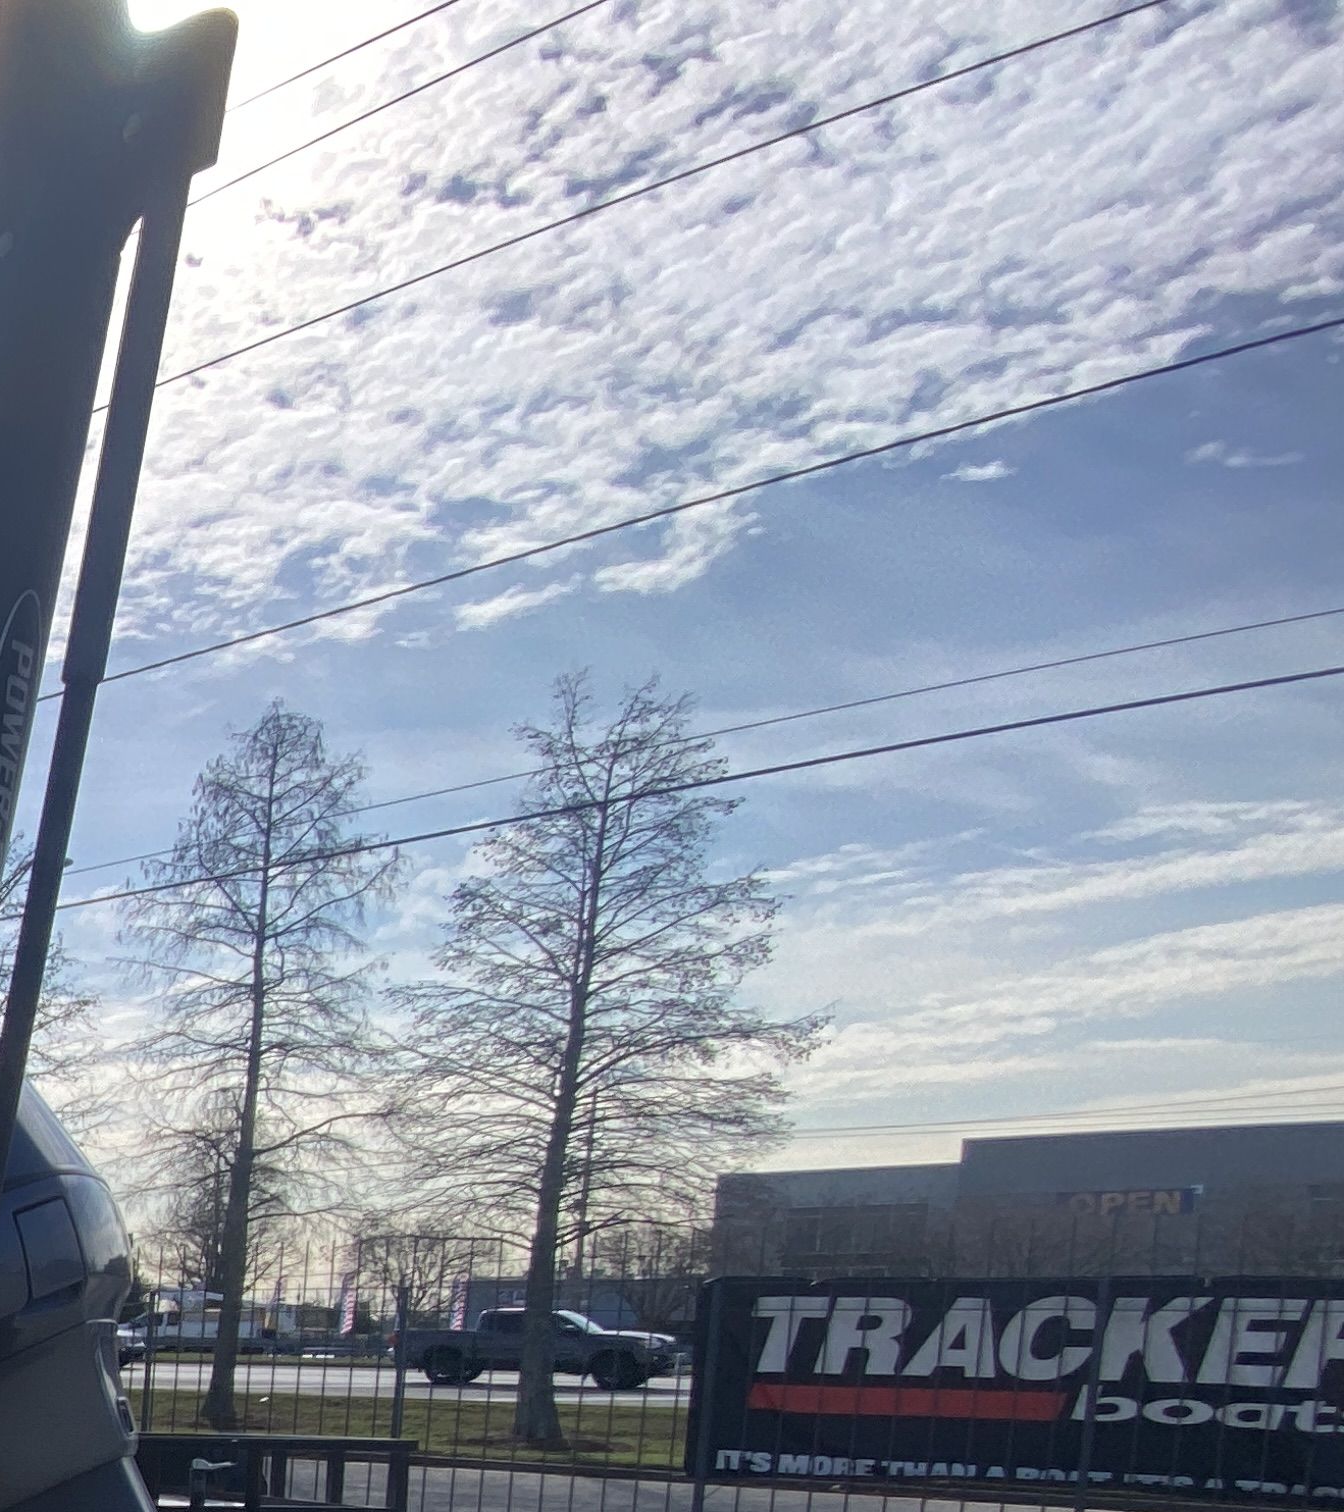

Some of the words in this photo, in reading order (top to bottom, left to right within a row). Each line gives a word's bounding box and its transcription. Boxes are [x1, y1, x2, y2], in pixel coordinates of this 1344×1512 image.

[1069, 1190, 1181, 1216] OPEN
[1070, 1384, 1344, 1434] boat
[715, 1450, 772, 1473] IT'S
[777, 1453, 876, 1477] MORE
